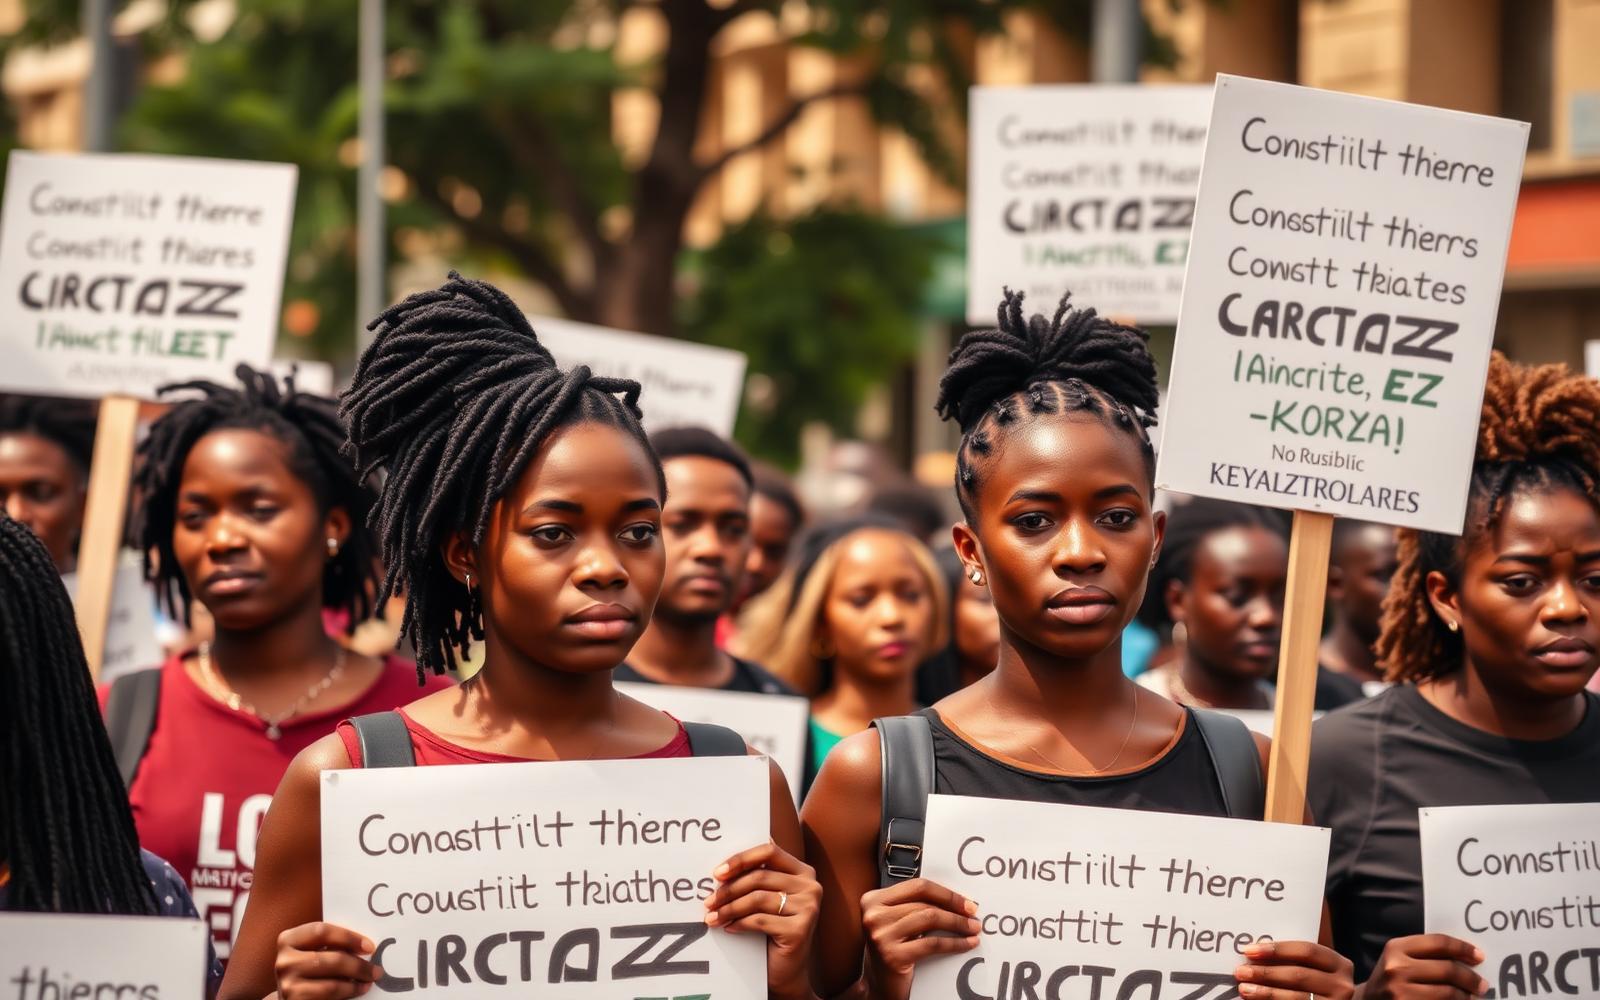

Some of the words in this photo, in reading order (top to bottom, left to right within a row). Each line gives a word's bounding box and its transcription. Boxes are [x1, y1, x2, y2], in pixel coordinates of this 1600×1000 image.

[1382, 369, 1444, 408] EZ
[1272, 444, 1295, 463] No
[1300, 447, 1365, 472] Rusiblic
[1210, 463, 1420, 514] KEYALZTROLARES
